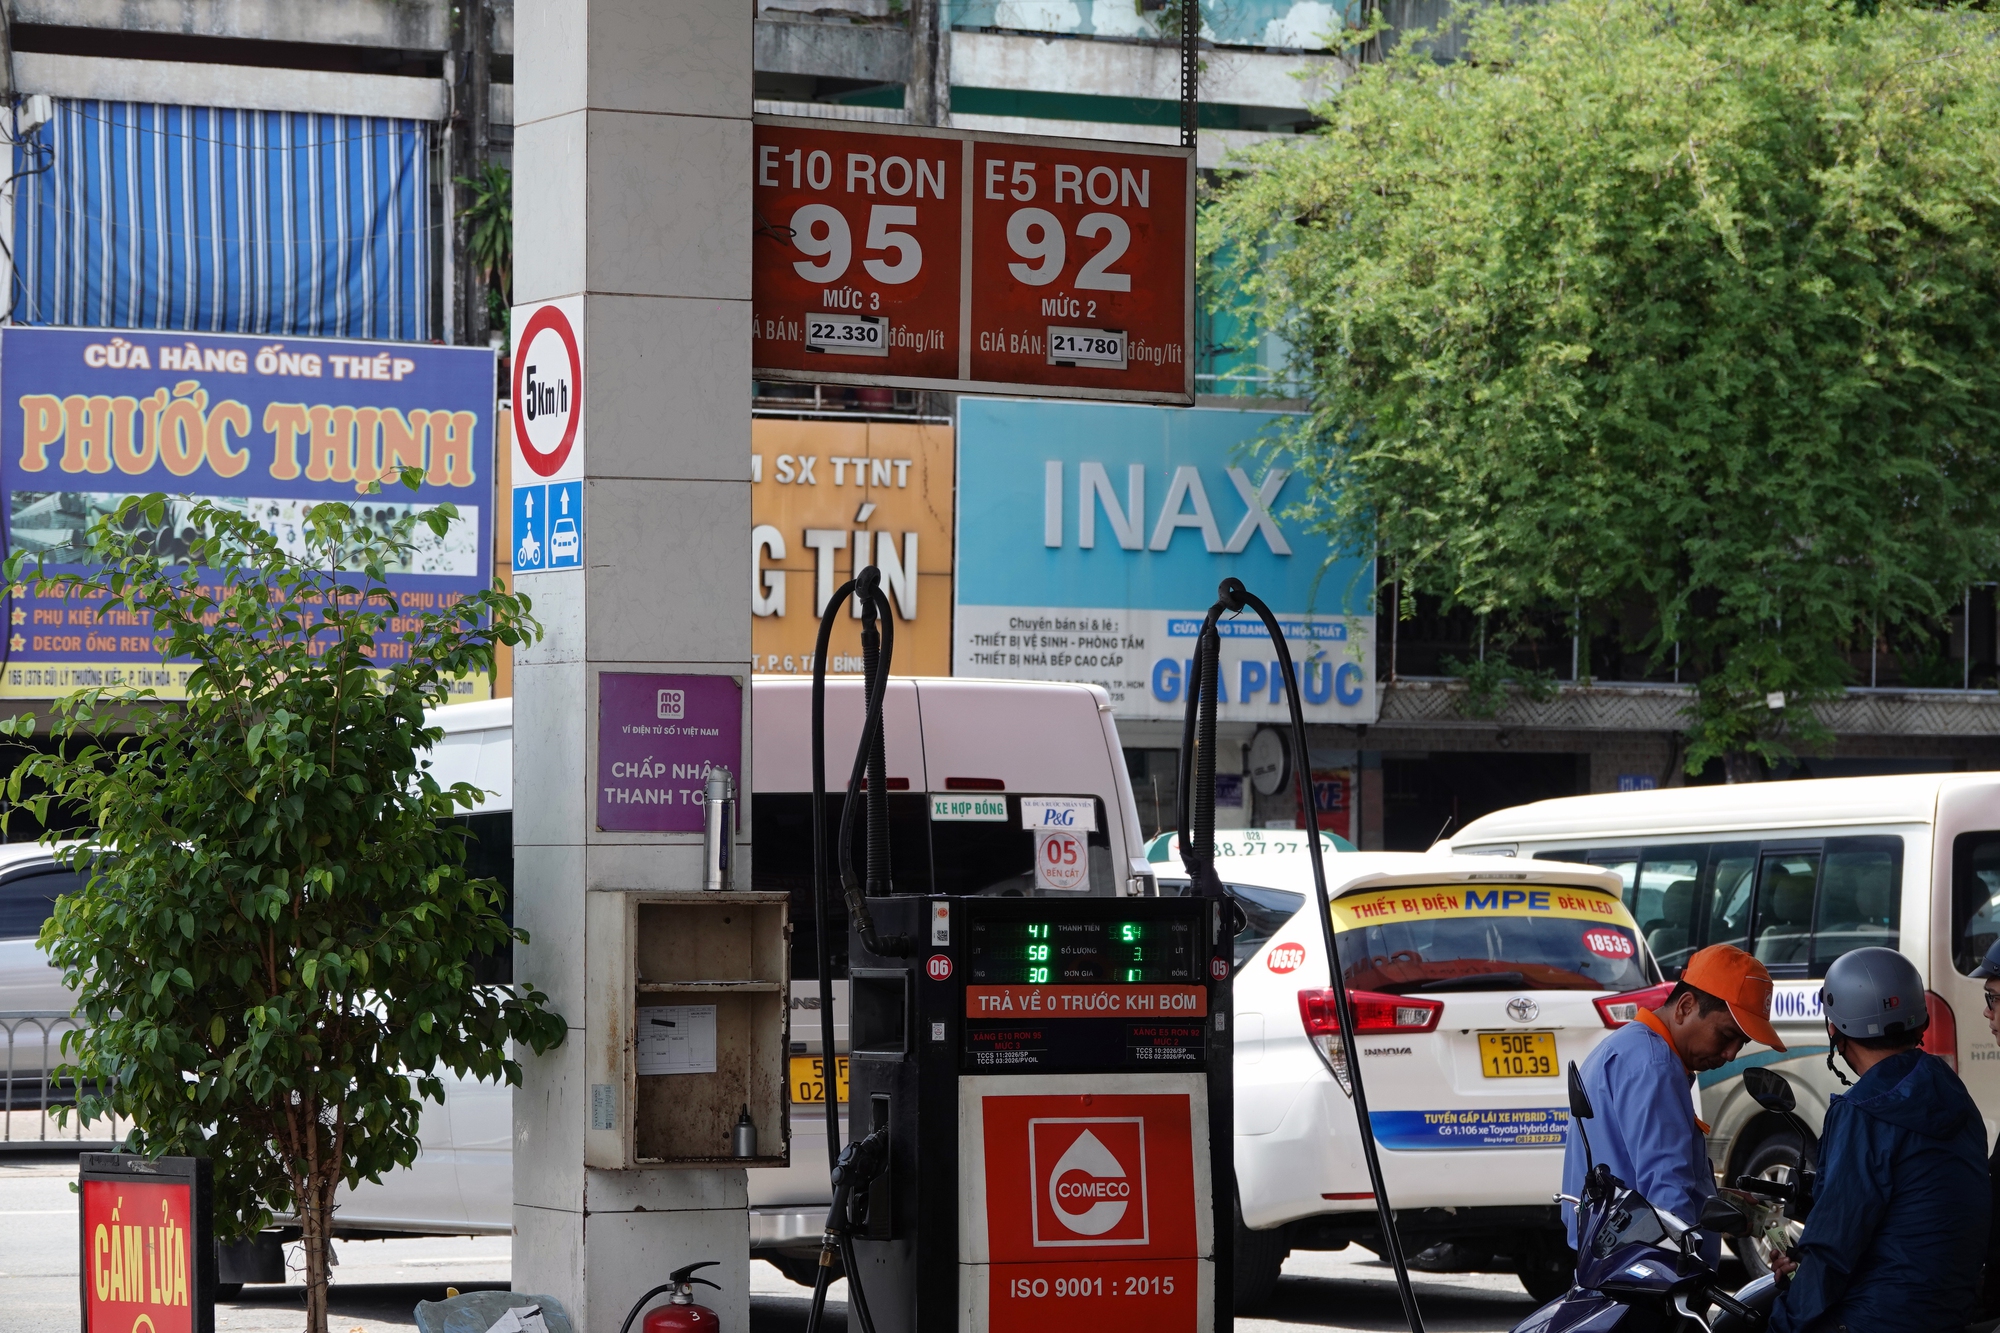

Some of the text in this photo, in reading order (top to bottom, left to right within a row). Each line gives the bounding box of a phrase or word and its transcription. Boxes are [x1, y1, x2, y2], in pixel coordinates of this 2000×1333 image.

[758, 145, 945, 200] E10 RON
[985, 160, 1150, 208] E5 RON
[789, 203, 923, 285] 95
[1006, 207, 1132, 293] 92
[823, 288, 881, 311] MỨC 3
[1041, 291, 1097, 319] MỨC 2
[766, 316, 945, 354] BÁN: 22.330 đồng/lít
[979, 327, 1182, 366] GIÁ BÁN: 21.780 đồng/lít
[84, 338, 415, 382] CỬA HÀNG ỐNG THÉP
[19, 380, 478, 495] PHƯỚC THỊNH
[775, 454, 818, 485] SX
[830, 456, 913, 488] TTNT
[1044, 460, 1293, 556] INAX
[804, 502, 918, 621] TÍN
[401, 592, 434, 611] CHỊU
[33, 609, 63, 628] PHỤ
[68, 606, 103, 628] KIỆN
[1009, 617, 1051, 631] Chuyên
[1055, 617, 1076, 630] bán
[1091, 619, 1099, 631] &
[1173, 620, 1198, 633] CỬA
[33, 636, 82, 652] DECOR
[86, 631, 117, 652] ỐNG
[120, 637, 150, 652] REN
[381, 639, 404, 659] TRÍ
[1009, 635, 1021, 649] BỊ
[1023, 634, 1038, 649] VỆ
[1040, 637, 1068, 648] SINH
[1078, 636, 1118, 649] PHÒNG
[1009, 654, 1021, 667] BỊ
[1023, 653, 1048, 666] NHÀ
[1051, 652, 1072, 667] BẾP
[1075, 656, 1098, 667] CAO
[1100, 652, 1123, 668] CẤP
[8, 669, 21, 685] 165
[60, 667, 69, 685] LÝ
[71, 666, 102, 686] THƯỜNG
[104, 667, 122, 689] KIỆT
[1240, 650, 1364, 707] PHÚC
[622, 724, 719, 737] VÍ ĐIỆN TỬ SỐ 1 VIỆT NAM
[611, 755, 666, 780] CHẤP
[604, 787, 673, 806] THANH
[935, 798, 1004, 818] XE HỢP ĐỒNG
[1043, 808, 1075, 826] P&G
[1046, 839, 1078, 865] 05
[1046, 866, 1080, 878] BẾN CÁT
[1351, 891, 1613, 919] THIẾT BỊ ĐIỆN MPE ĐÈN LED
[1028, 924, 1049, 938] 41
[1028, 945, 1049, 961] 58
[1061, 945, 1071, 954] SỐ
[1073, 946, 1098, 956] LƯỢNG
[1586, 932, 1632, 955] 18535
[1268, 947, 1304, 967] 18535
[930, 959, 949, 976] 06
[1028, 967, 1049, 983] 30
[1081, 969, 1094, 978] GIÁ
[1212, 960, 1227, 976] 05
[979, 989, 1196, 1012] TRẢ VỀ 0 TRƯỚC KHI BƠM
[1883, 996, 1899, 1009] HD
[973, 1032, 996, 1041] XĂNG
[1014, 1032, 1030, 1040] RON
[1032, 1032, 1042, 1040] 95
[1133, 1028, 1157, 1036] XĂNG
[1190, 1029, 1200, 1037] 92
[1153, 1037, 1179, 1046] MỨC 2
[994, 1041, 1021, 1050] MỨC 3
[1364, 1046, 1412, 1058] INNOVA
[1501, 1034, 1534, 1055] 50E
[1492, 1056, 1549, 1076] 110.39
[1424, 1110, 1546, 1125] TUYỂN GẤP LÁI XE HYBRID
[1439, 1125, 1451, 1136] Có
[1453, 1126, 1477, 1135] 1.106
[1489, 1125, 1518, 1136] Toyota
[1519, 1124, 1548, 1136] Hybrid
[1058, 1182, 1131, 1198] COMECO
[95, 1196, 188, 1307] CẤM LỬA
[1010, 1276, 1175, 1298] ISO 9001 2015
[689, 1310, 700, 1322] 3
